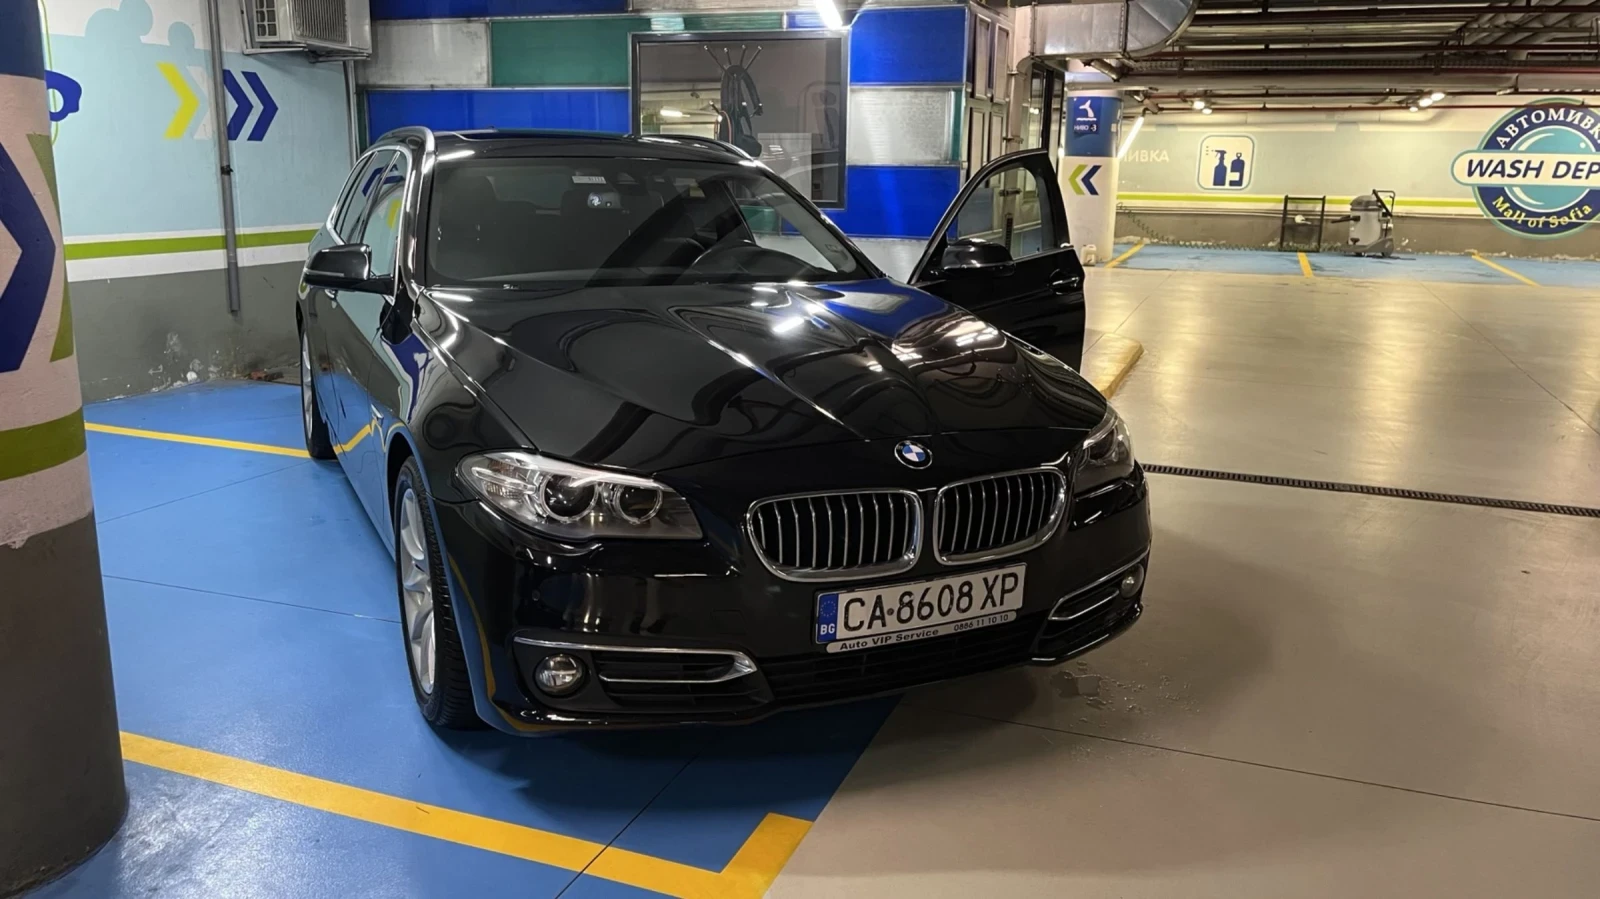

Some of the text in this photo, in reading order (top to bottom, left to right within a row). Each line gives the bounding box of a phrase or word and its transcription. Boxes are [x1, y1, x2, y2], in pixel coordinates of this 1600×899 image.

[1496, 107, 1600, 148] АВТОМИВК
[1467, 159, 1544, 178] WASH
[1492, 196, 1592, 228] Mall of Sofia
[980, 572, 1019, 610] XP
[820, 623, 836, 635] BG
[840, 641, 868, 650] Auto
[872, 635, 892, 645] VIP
[896, 630, 939, 642] Service
